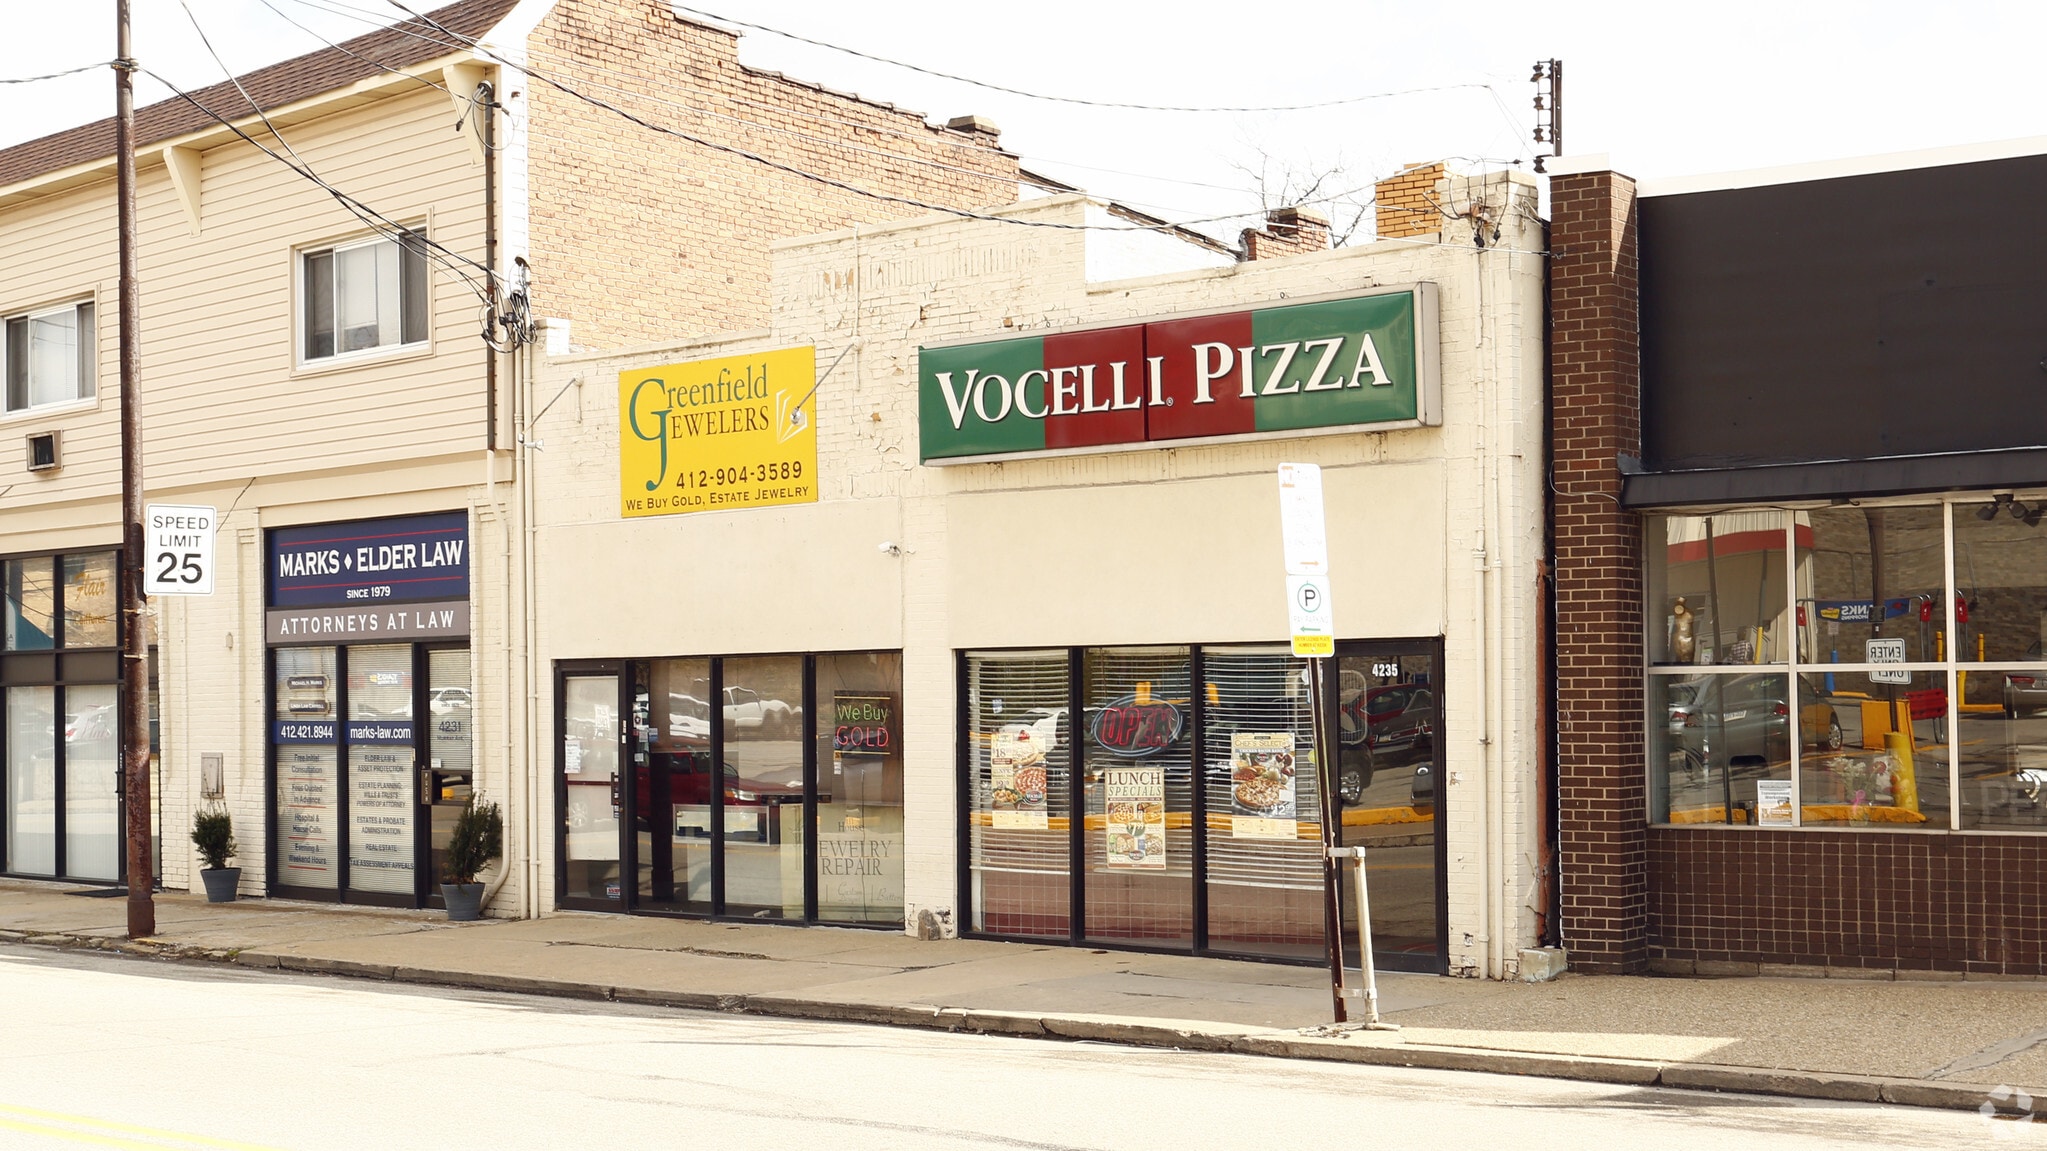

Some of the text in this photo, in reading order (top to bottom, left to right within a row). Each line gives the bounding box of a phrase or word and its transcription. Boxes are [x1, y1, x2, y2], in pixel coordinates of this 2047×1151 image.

[935, 333, 1393, 430] VOCELLI PIZZA
[629, 363, 768, 441] Greenfield
[676, 461, 802, 489] 412-904-3589
[153, 515, 209, 530] SPEED
[160, 534, 202, 548] LIMIT
[279, 540, 464, 577] MARKS ELDER LAW
[156, 553, 203, 584] 25
[346, 586, 391, 599] SINCE 1979
[1304, 590, 1316, 606] P
[280, 610, 455, 635] ATTORNEYS AT LAW
[1372, 664, 1398, 677] 4235
[837, 704, 888, 726] We Buy
[281, 725, 333, 739] 412.421.8944
[350, 725, 411, 739] marks-law.com
[439, 721, 461, 733] 4231
[1102, 708, 1172, 747] OPEN
[836, 725, 889, 747] GOLD
[1108, 772, 1161, 786] LUNCH
[1109, 786, 1162, 797] SPECIALS
[822, 858, 883, 876] REPAIR
